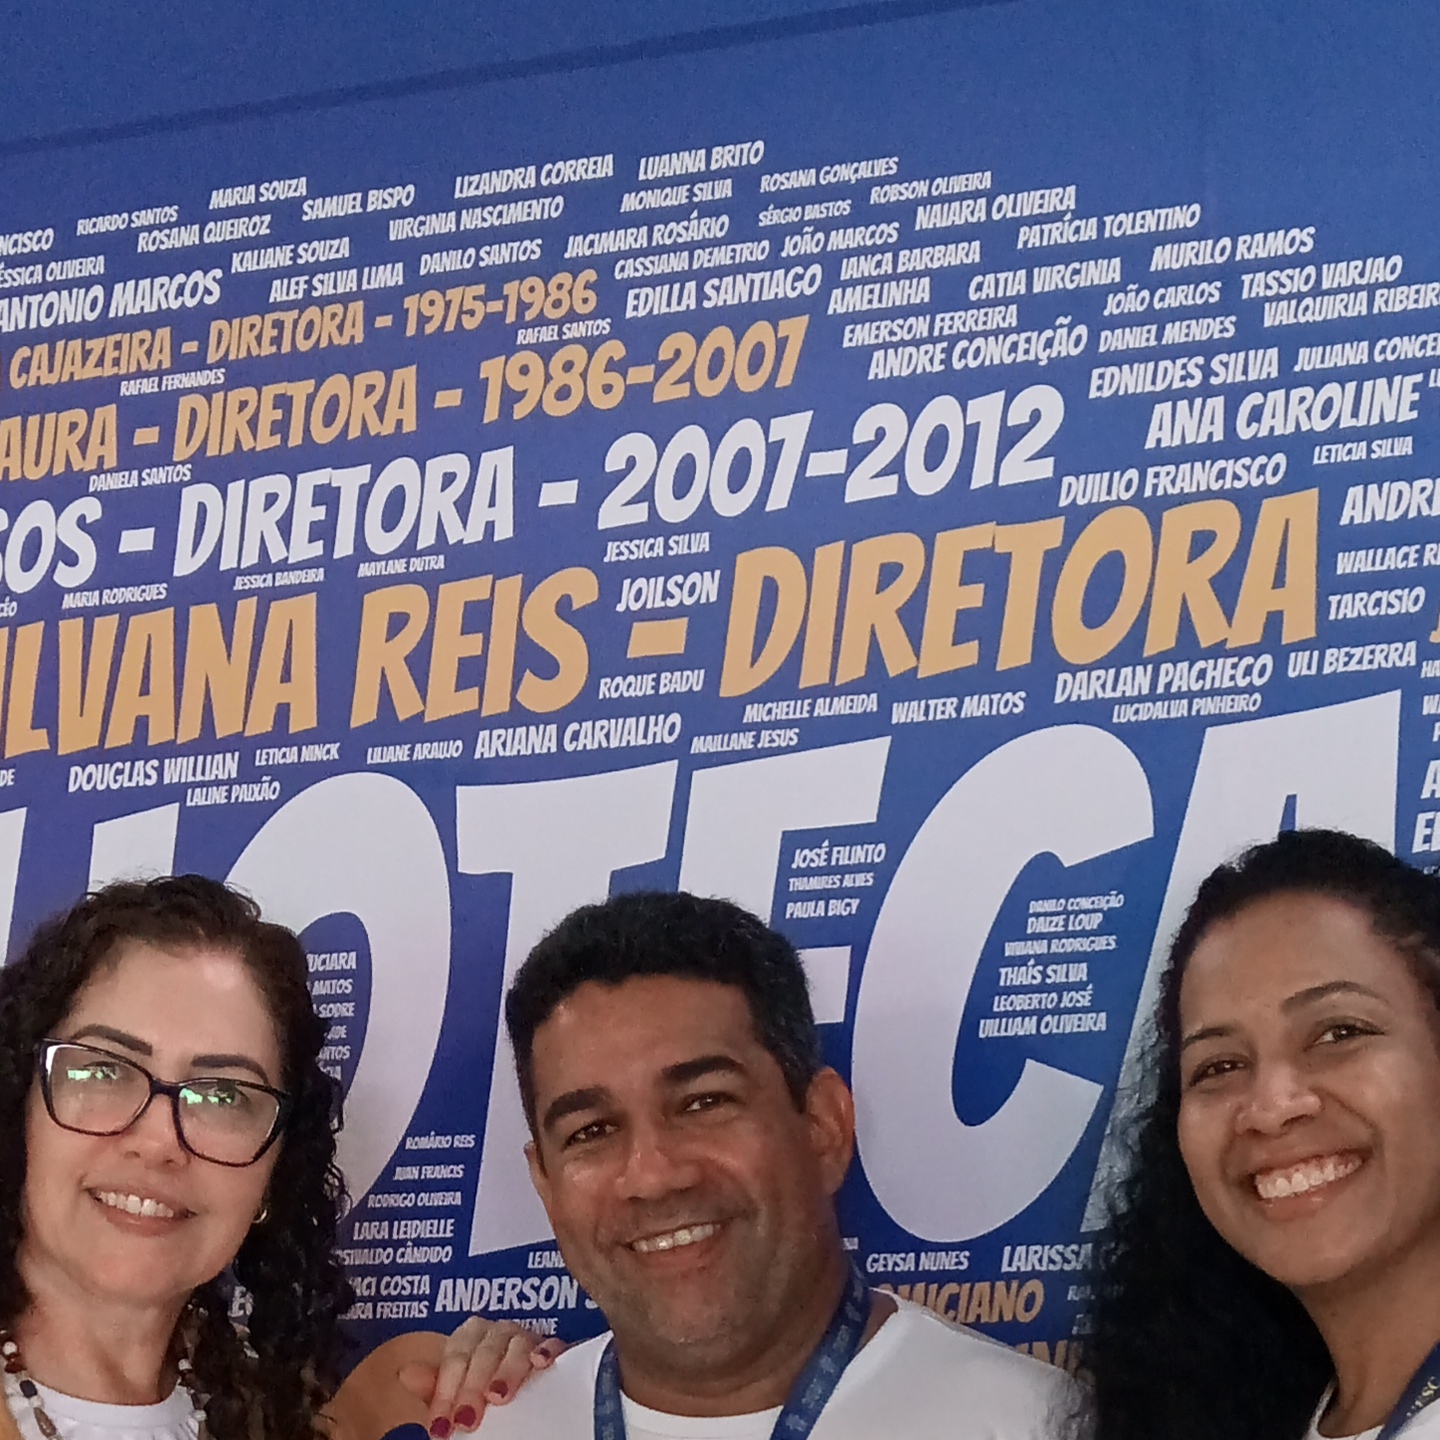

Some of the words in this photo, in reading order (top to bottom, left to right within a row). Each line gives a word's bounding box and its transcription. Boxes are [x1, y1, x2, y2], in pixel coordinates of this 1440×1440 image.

[639, 149, 705, 180] LUANNA
[710, 141, 764, 170] BRITO
[1150, 237, 1231, 271] MURILO
[1235, 227, 1315, 261] RAMOS
[109, 269, 222, 318] MARCOS
[626, 281, 696, 318] EDILLA
[703, 264, 822, 308] SANTIAGO
[10, 327, 171, 394] CAJAZEIRA
[181, 341, 198, 353] -
[207, 300, 364, 364] DIRETORA
[375, 315, 392, 327] -
[404, 269, 603, 341] 1975-1986
[133, 426, 159, 445] -
[168, 365, 416, 461] DIRETORA
[434, 389, 462, 408] -
[480, 315, 809, 423] 1986-2007
[1089, 356, 1204, 398] EDNILDES
[1210, 347, 1278, 385] SILVA
[1145, 396, 1224, 449] ANA
[1236, 373, 1423, 439] CAROLINE
[119, 528, 155, 553] -
[173, 441, 513, 582] DIRETORA
[538, 480, 578, 507] -
[598, 380, 1070, 530] 2007-2012
[350, 567, 598, 728] REIS
[627, 617, 688, 658] -
[714, 482, 1319, 703] DIRETORA
[616, 570, 720, 612] JOILSON
[792, 840, 829, 868] JOSÉ
[831, 843, 886, 865] FILINTO
